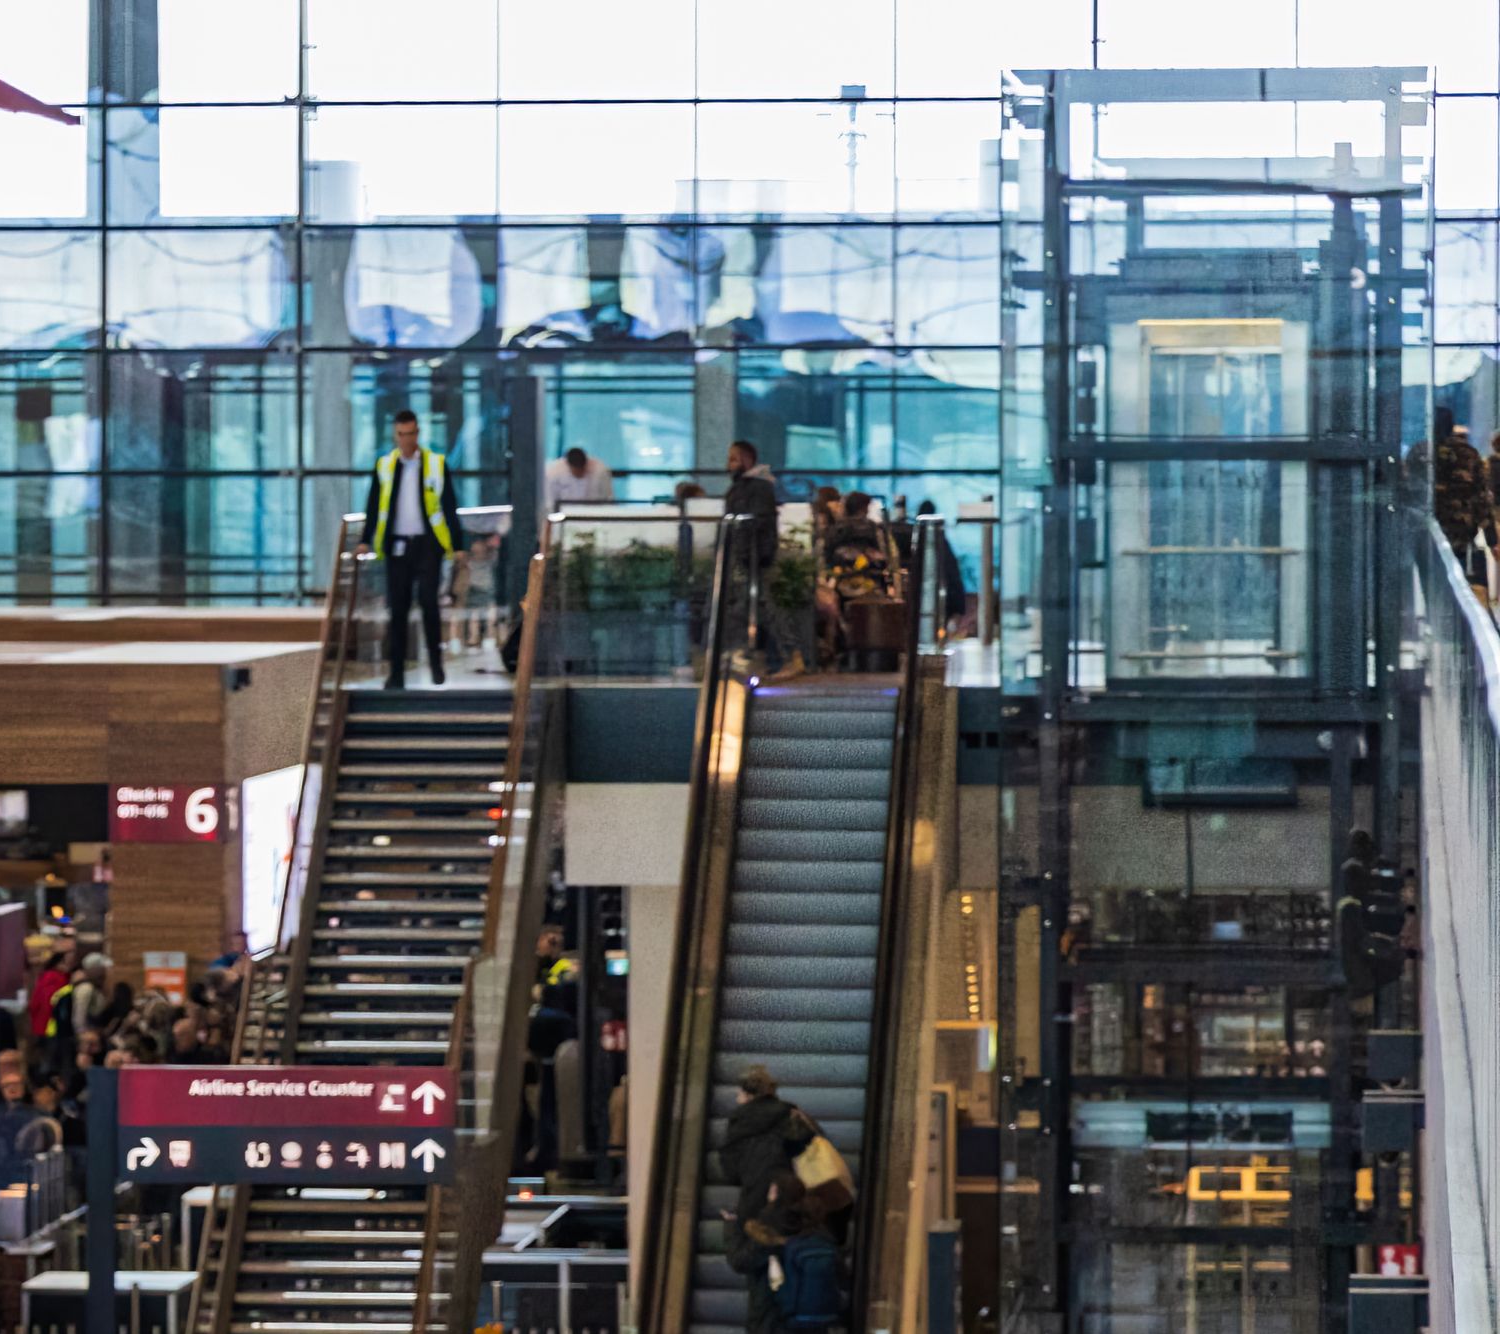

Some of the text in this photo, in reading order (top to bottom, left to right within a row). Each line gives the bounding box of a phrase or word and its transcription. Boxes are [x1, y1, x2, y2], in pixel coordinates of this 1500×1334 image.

[185, 787, 218, 833] 6
[188, 1079, 375, 1097] Airline Service Counter
